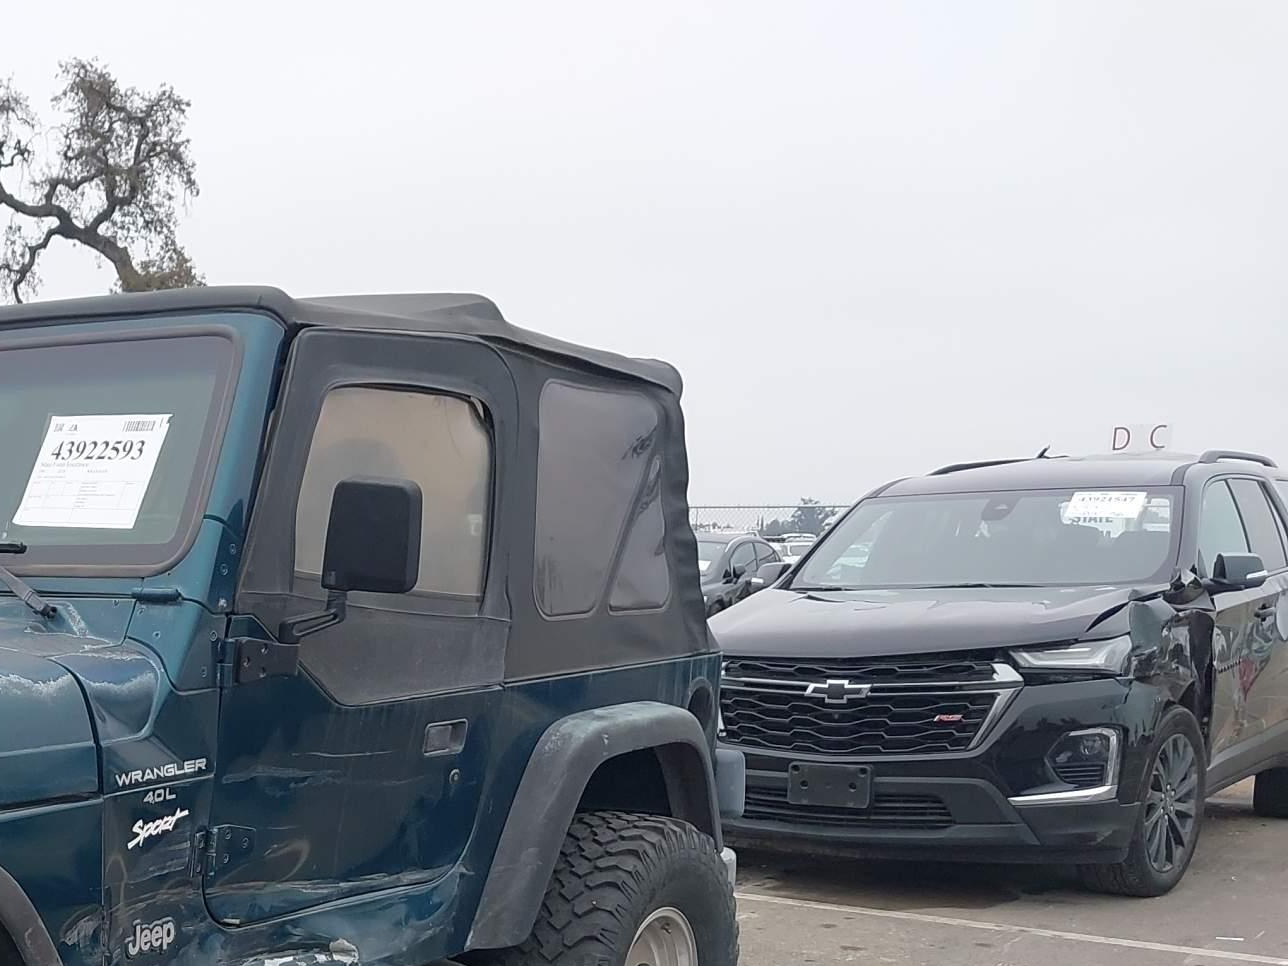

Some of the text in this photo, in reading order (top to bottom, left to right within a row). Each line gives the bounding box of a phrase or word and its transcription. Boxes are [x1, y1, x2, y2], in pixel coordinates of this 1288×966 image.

[51, 439, 145, 460] 43922593
[1112, 424, 1167, 451] D C
[115, 757, 207, 787] WRANGLER
[127, 808, 189, 850] Sport
[125, 917, 175, 956] Jeep
